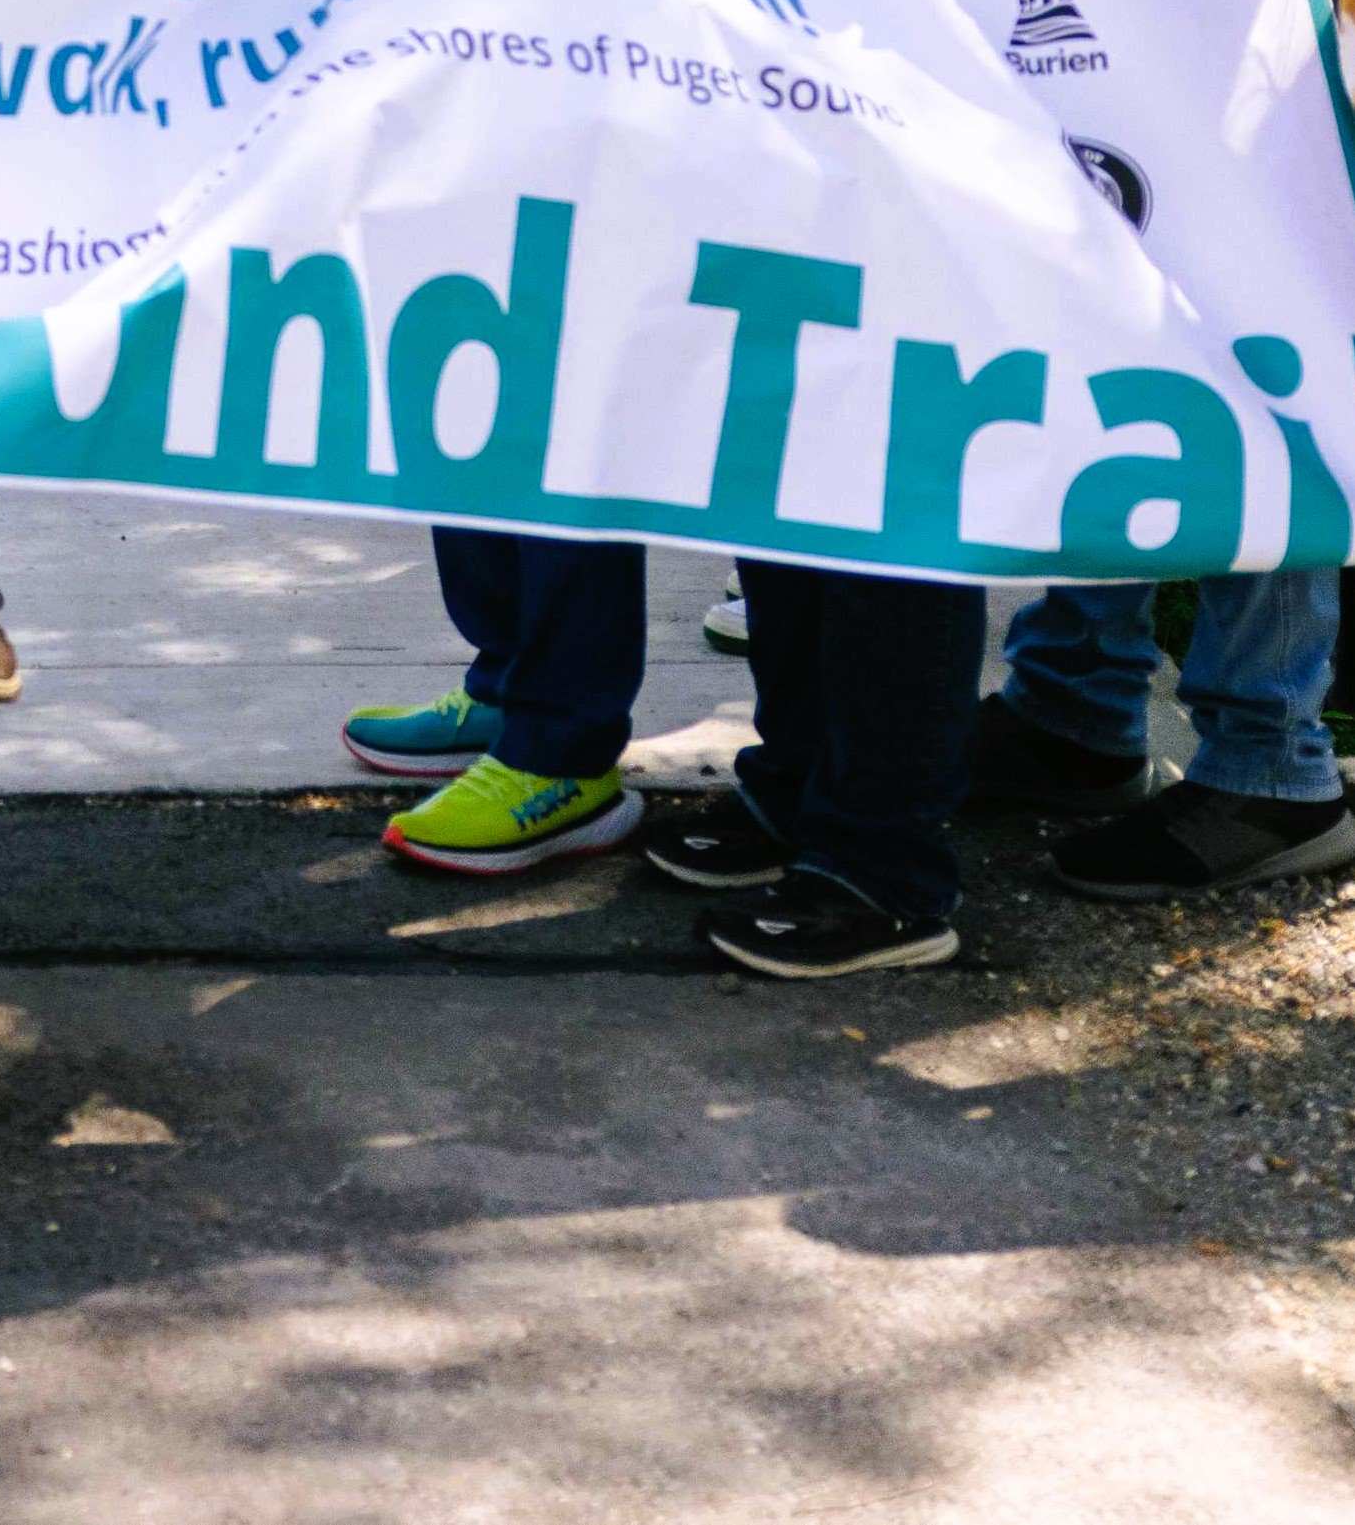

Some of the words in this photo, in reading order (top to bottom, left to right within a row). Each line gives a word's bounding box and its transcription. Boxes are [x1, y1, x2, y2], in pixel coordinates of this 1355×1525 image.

[386, 24, 553, 70] shores
[566, 34, 612, 76] of
[626, 38, 748, 106] Puget
[1004, 46, 1109, 76] Burien
[689, 239, 1355, 572] Trai
